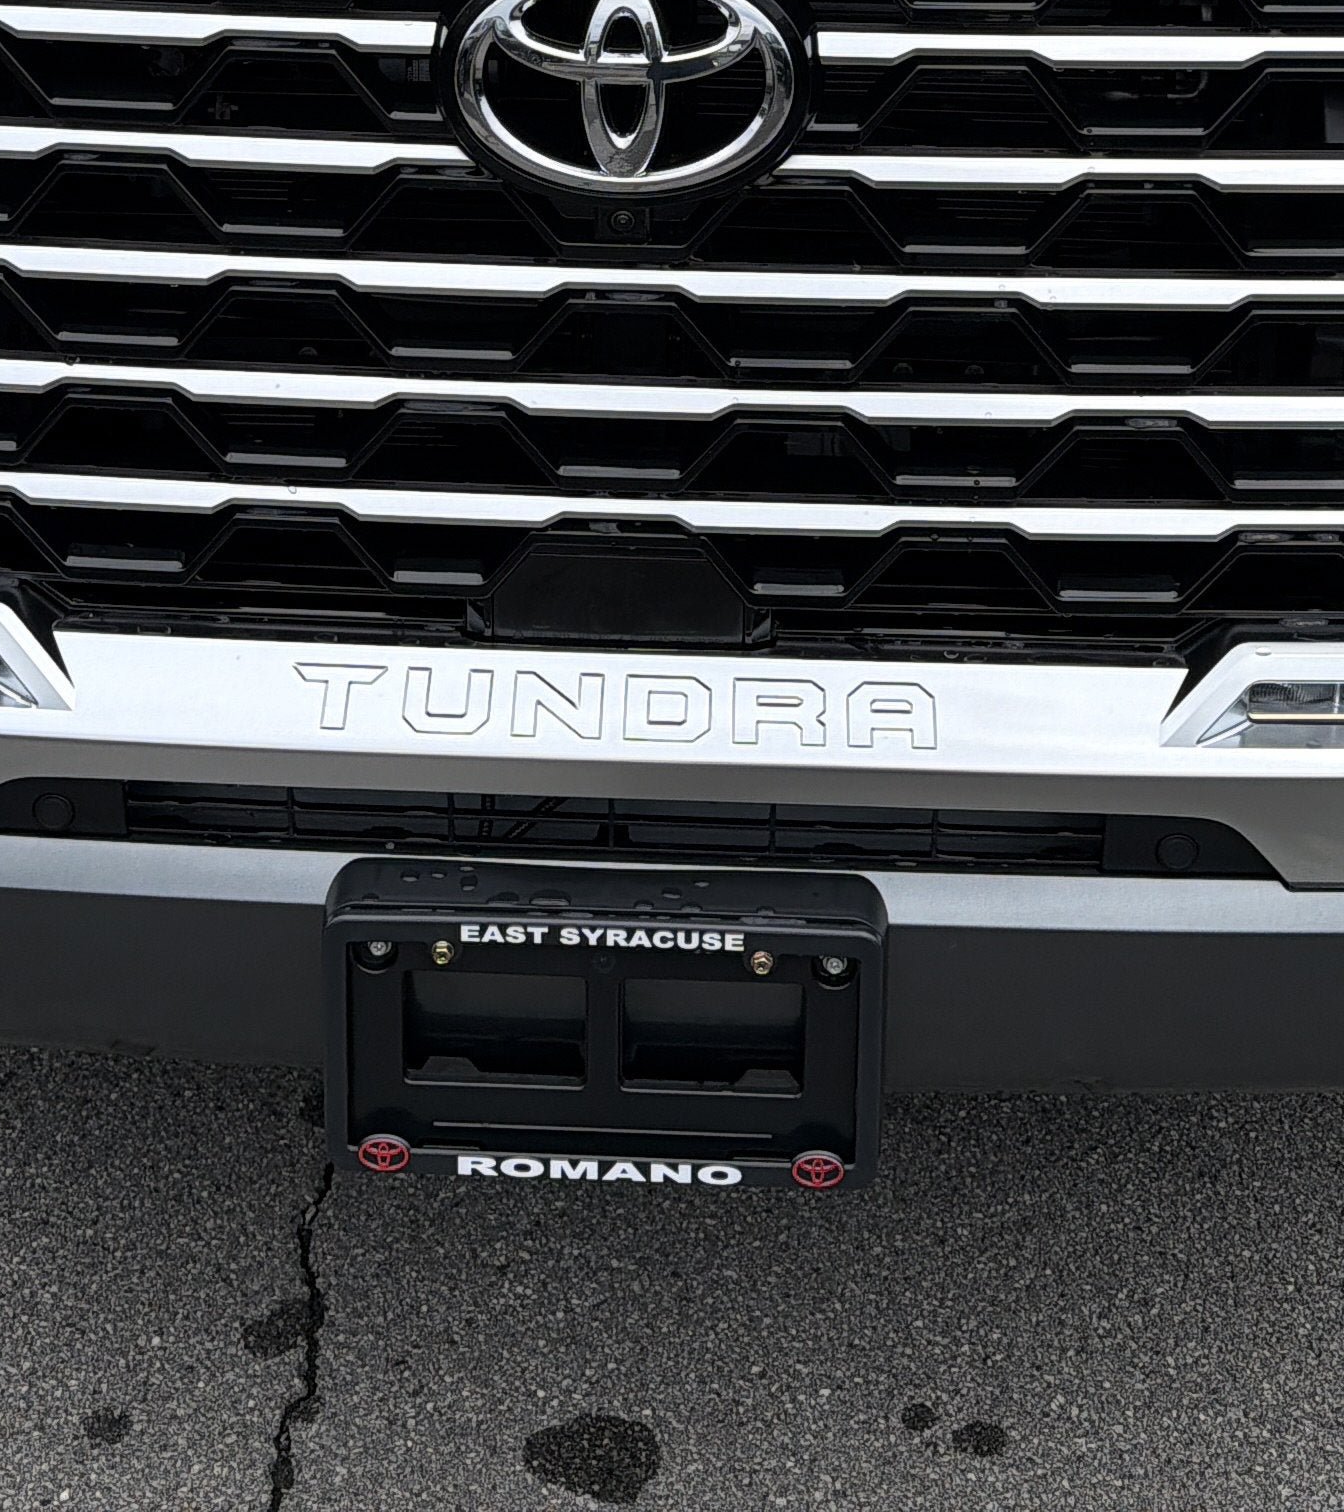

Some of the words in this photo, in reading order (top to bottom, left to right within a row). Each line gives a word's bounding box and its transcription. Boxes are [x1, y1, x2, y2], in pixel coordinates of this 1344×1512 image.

[293, 661, 938, 750] TUNDRA
[460, 924, 549, 944] EAST
[560, 927, 745, 952] SYRACUSE
[457, 1155, 743, 1186] ROMANO
